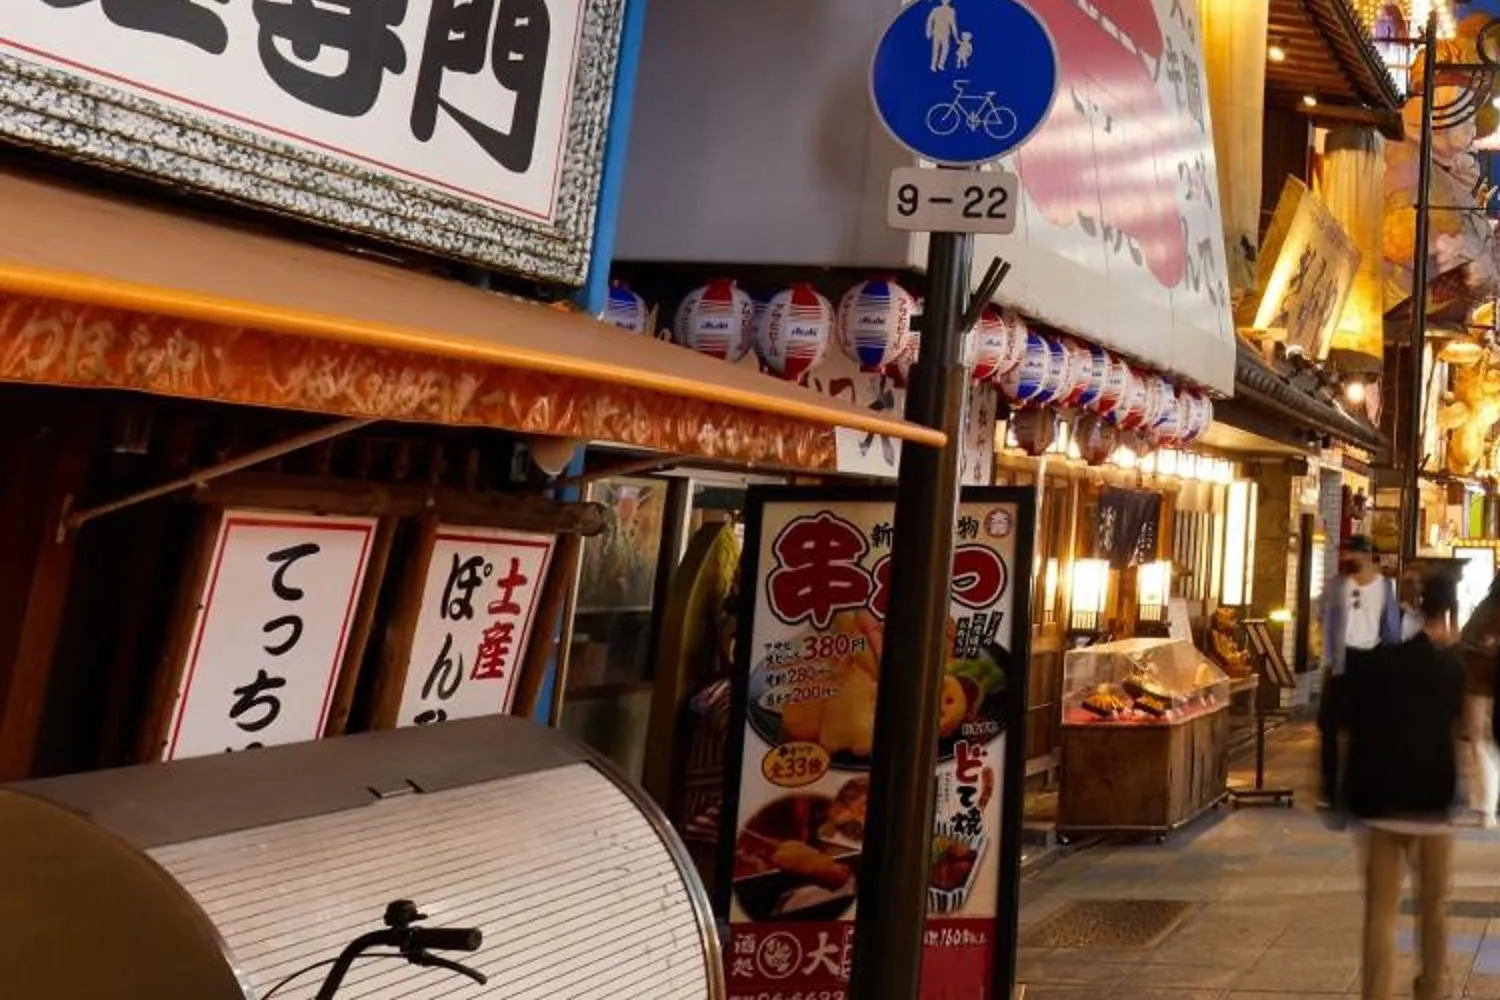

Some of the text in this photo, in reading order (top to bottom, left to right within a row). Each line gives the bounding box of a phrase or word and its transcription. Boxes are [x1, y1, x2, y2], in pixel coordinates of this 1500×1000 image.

[469, 557, 529, 682] 土産
[767, 510, 1008, 630] 串つ
[225, 542, 321, 752] てっち
